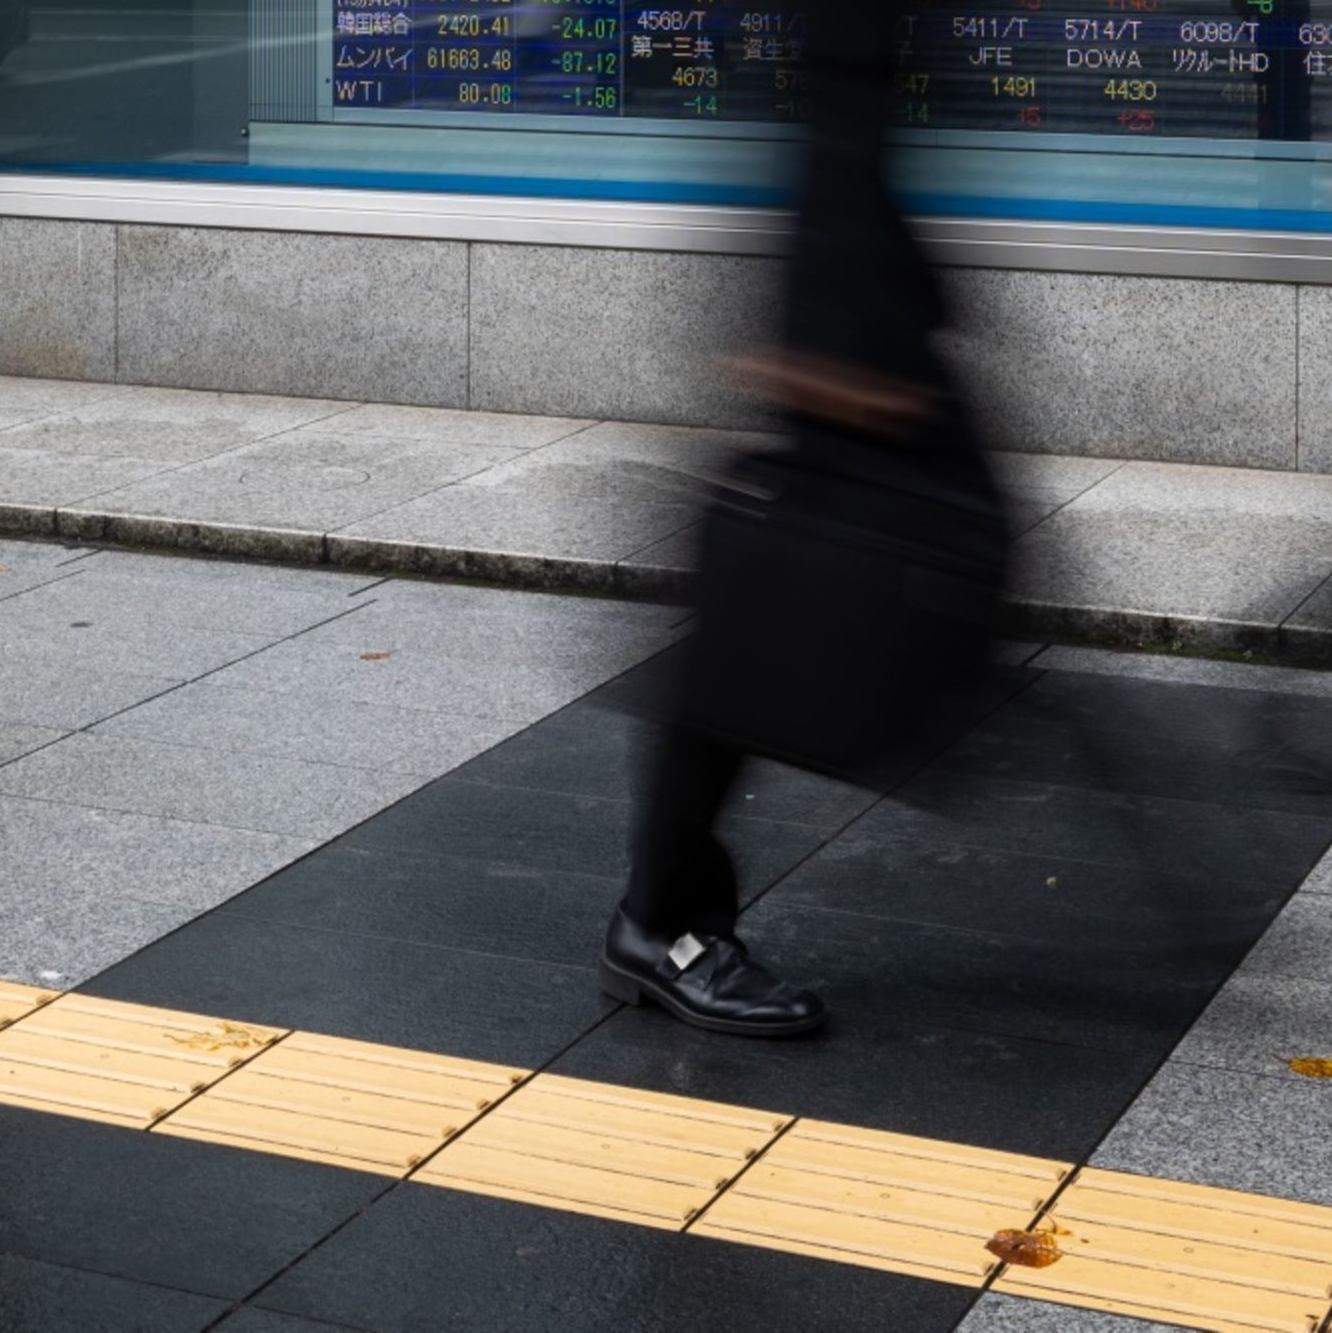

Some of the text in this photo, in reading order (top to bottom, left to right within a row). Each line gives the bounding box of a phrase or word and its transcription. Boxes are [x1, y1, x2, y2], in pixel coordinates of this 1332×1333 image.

[336, 12, 617, 39] 韓国総合 2420.41 -24.07
[637, 10, 706, 31] 4568/T
[953, 17, 1028, 39] 5411/T
[1065, 18, 1142, 40] 5714/T
[1180, 21, 1260, 43] 6098/T
[631, 35, 714, 58] 第一三共
[969, 47, 1012, 66] JFE
[336, 45, 413, 70] ムンバイ
[427, 49, 511, 71] 61663.48
[1067, 48, 1142, 68] DOWA
[336, 81, 617, 108] WTI 80.08 -1.56
